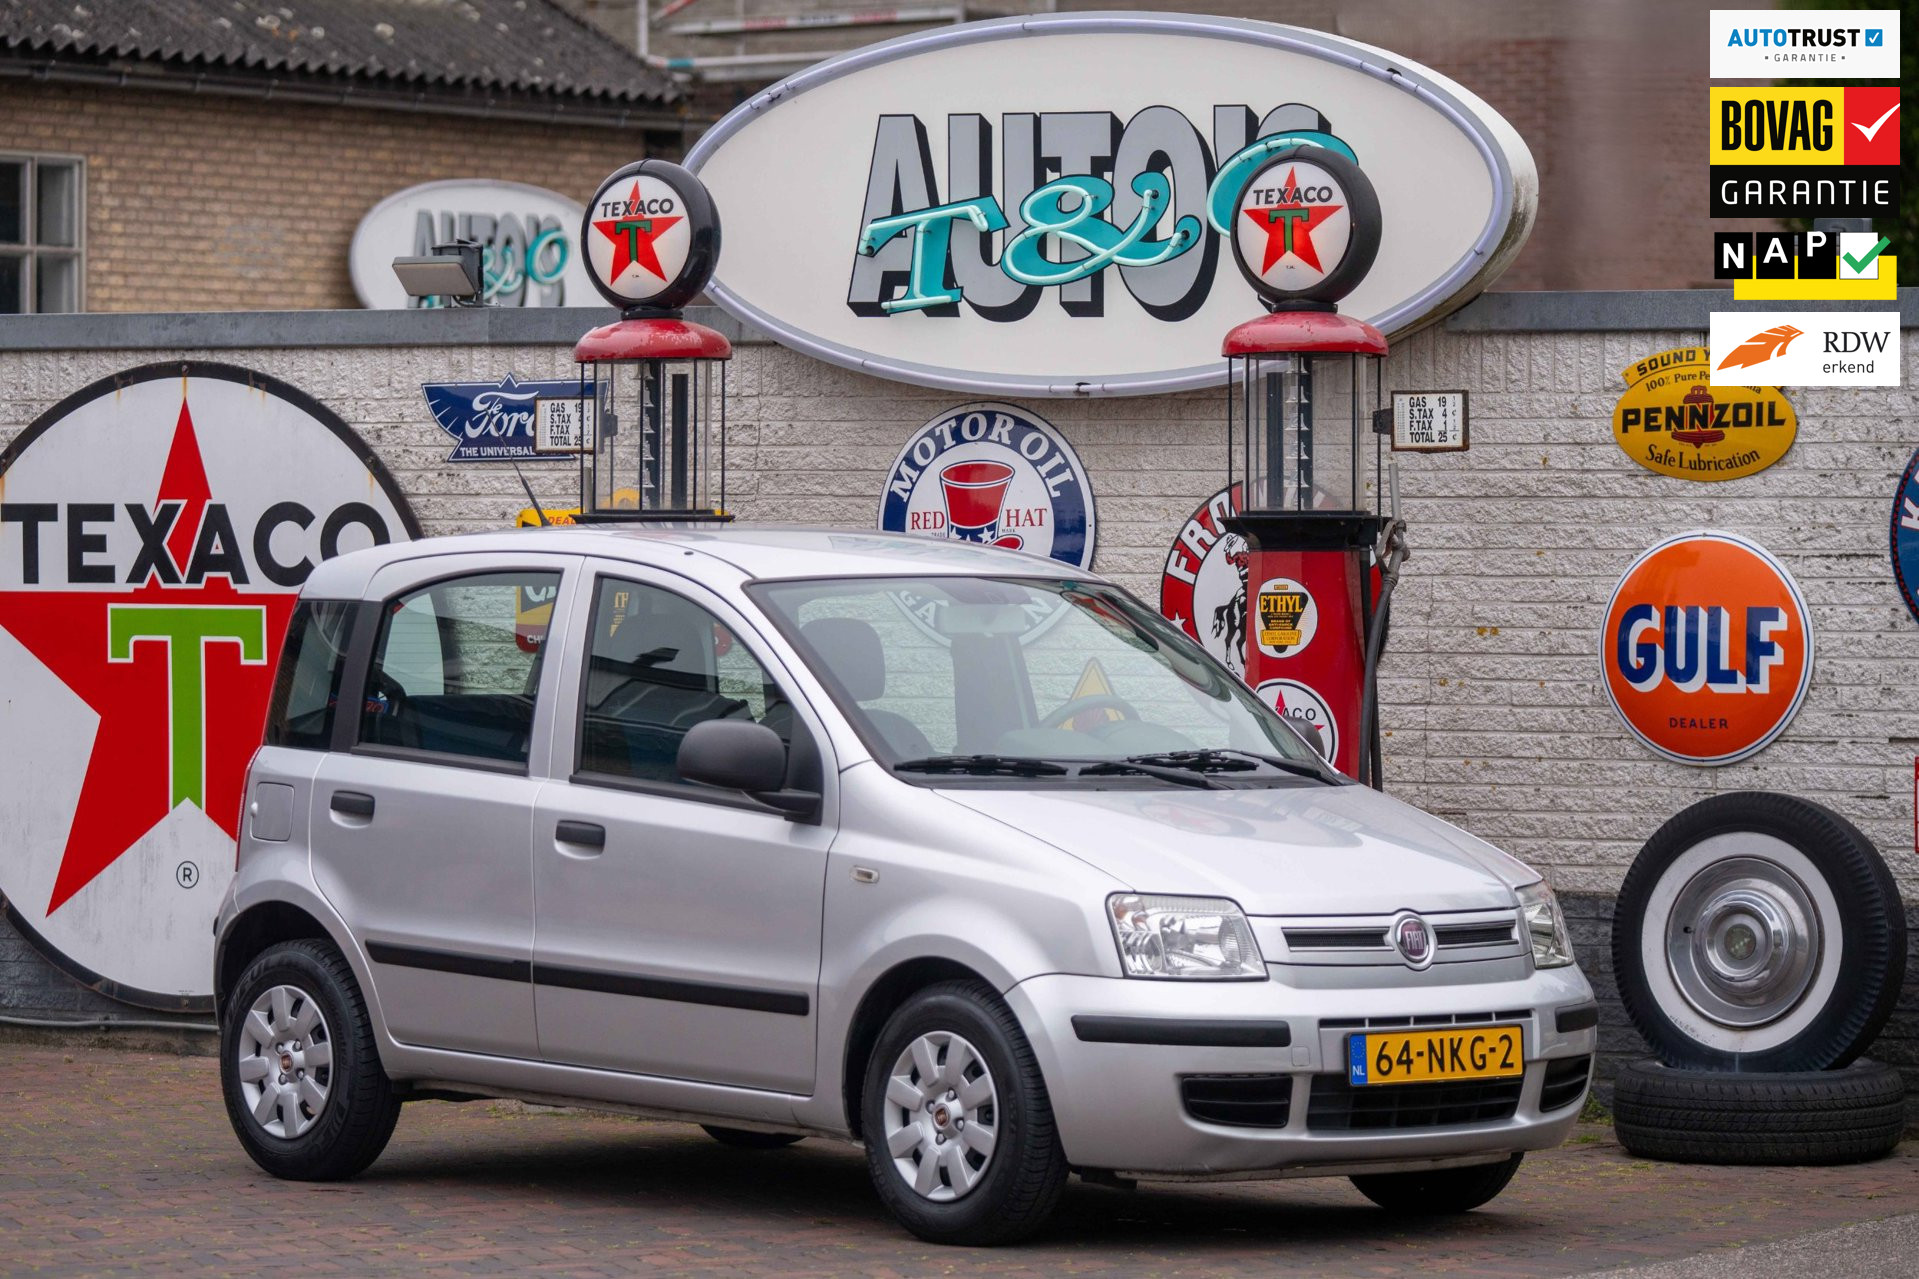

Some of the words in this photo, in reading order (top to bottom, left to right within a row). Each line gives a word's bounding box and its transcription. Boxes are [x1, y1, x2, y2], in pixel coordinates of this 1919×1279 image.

[1253, 186, 1333, 205] TEXACO
[601, 198, 674, 217] TEXACO
[1268, 208, 1310, 254] T
[615, 219, 653, 263] T
[1636, 350, 1696, 376] SOUND
[1674, 371, 1697, 383] Pure
[550, 402, 566, 413] GAS
[1409, 396, 1427, 408] GAS
[1438, 396, 1447, 408] 19
[550, 414, 571, 424] S.TAX
[1409, 408, 1434, 420] S.TAX
[1442, 408, 1448, 419] 4
[1621, 401, 1786, 434] PENNZOIL
[550, 425, 570, 435] F.TAX
[1409, 420, 1433, 431] F.TAX
[1443, 420, 1447, 431] 1
[550, 436, 572, 446] TOTAL
[1409, 432, 1435, 443] TOTAL
[1438, 432, 1448, 443] 25
[460, 447, 479, 457] THE
[480, 446, 536, 456] UNIVERSAL
[890, 412, 1015, 503] MOTOR
[1019, 431, 1075, 498] OIL
[1645, 444, 1676, 467] Safe
[1678, 450, 1761, 471] Lubrication
[911, 511, 945, 530] RED
[1006, 508, 1047, 527] HAT
[1260, 595, 1304, 613] ETHYL
[1617, 604, 1788, 694] GULF
[107, 603, 267, 814] T
[1669, 716, 1728, 729] DEALER
[1404, 930, 1425, 950] FIAT
[1376, 1034, 1514, 1076] 64-NKG-2
[1352, 1065, 1365, 1076] NL
